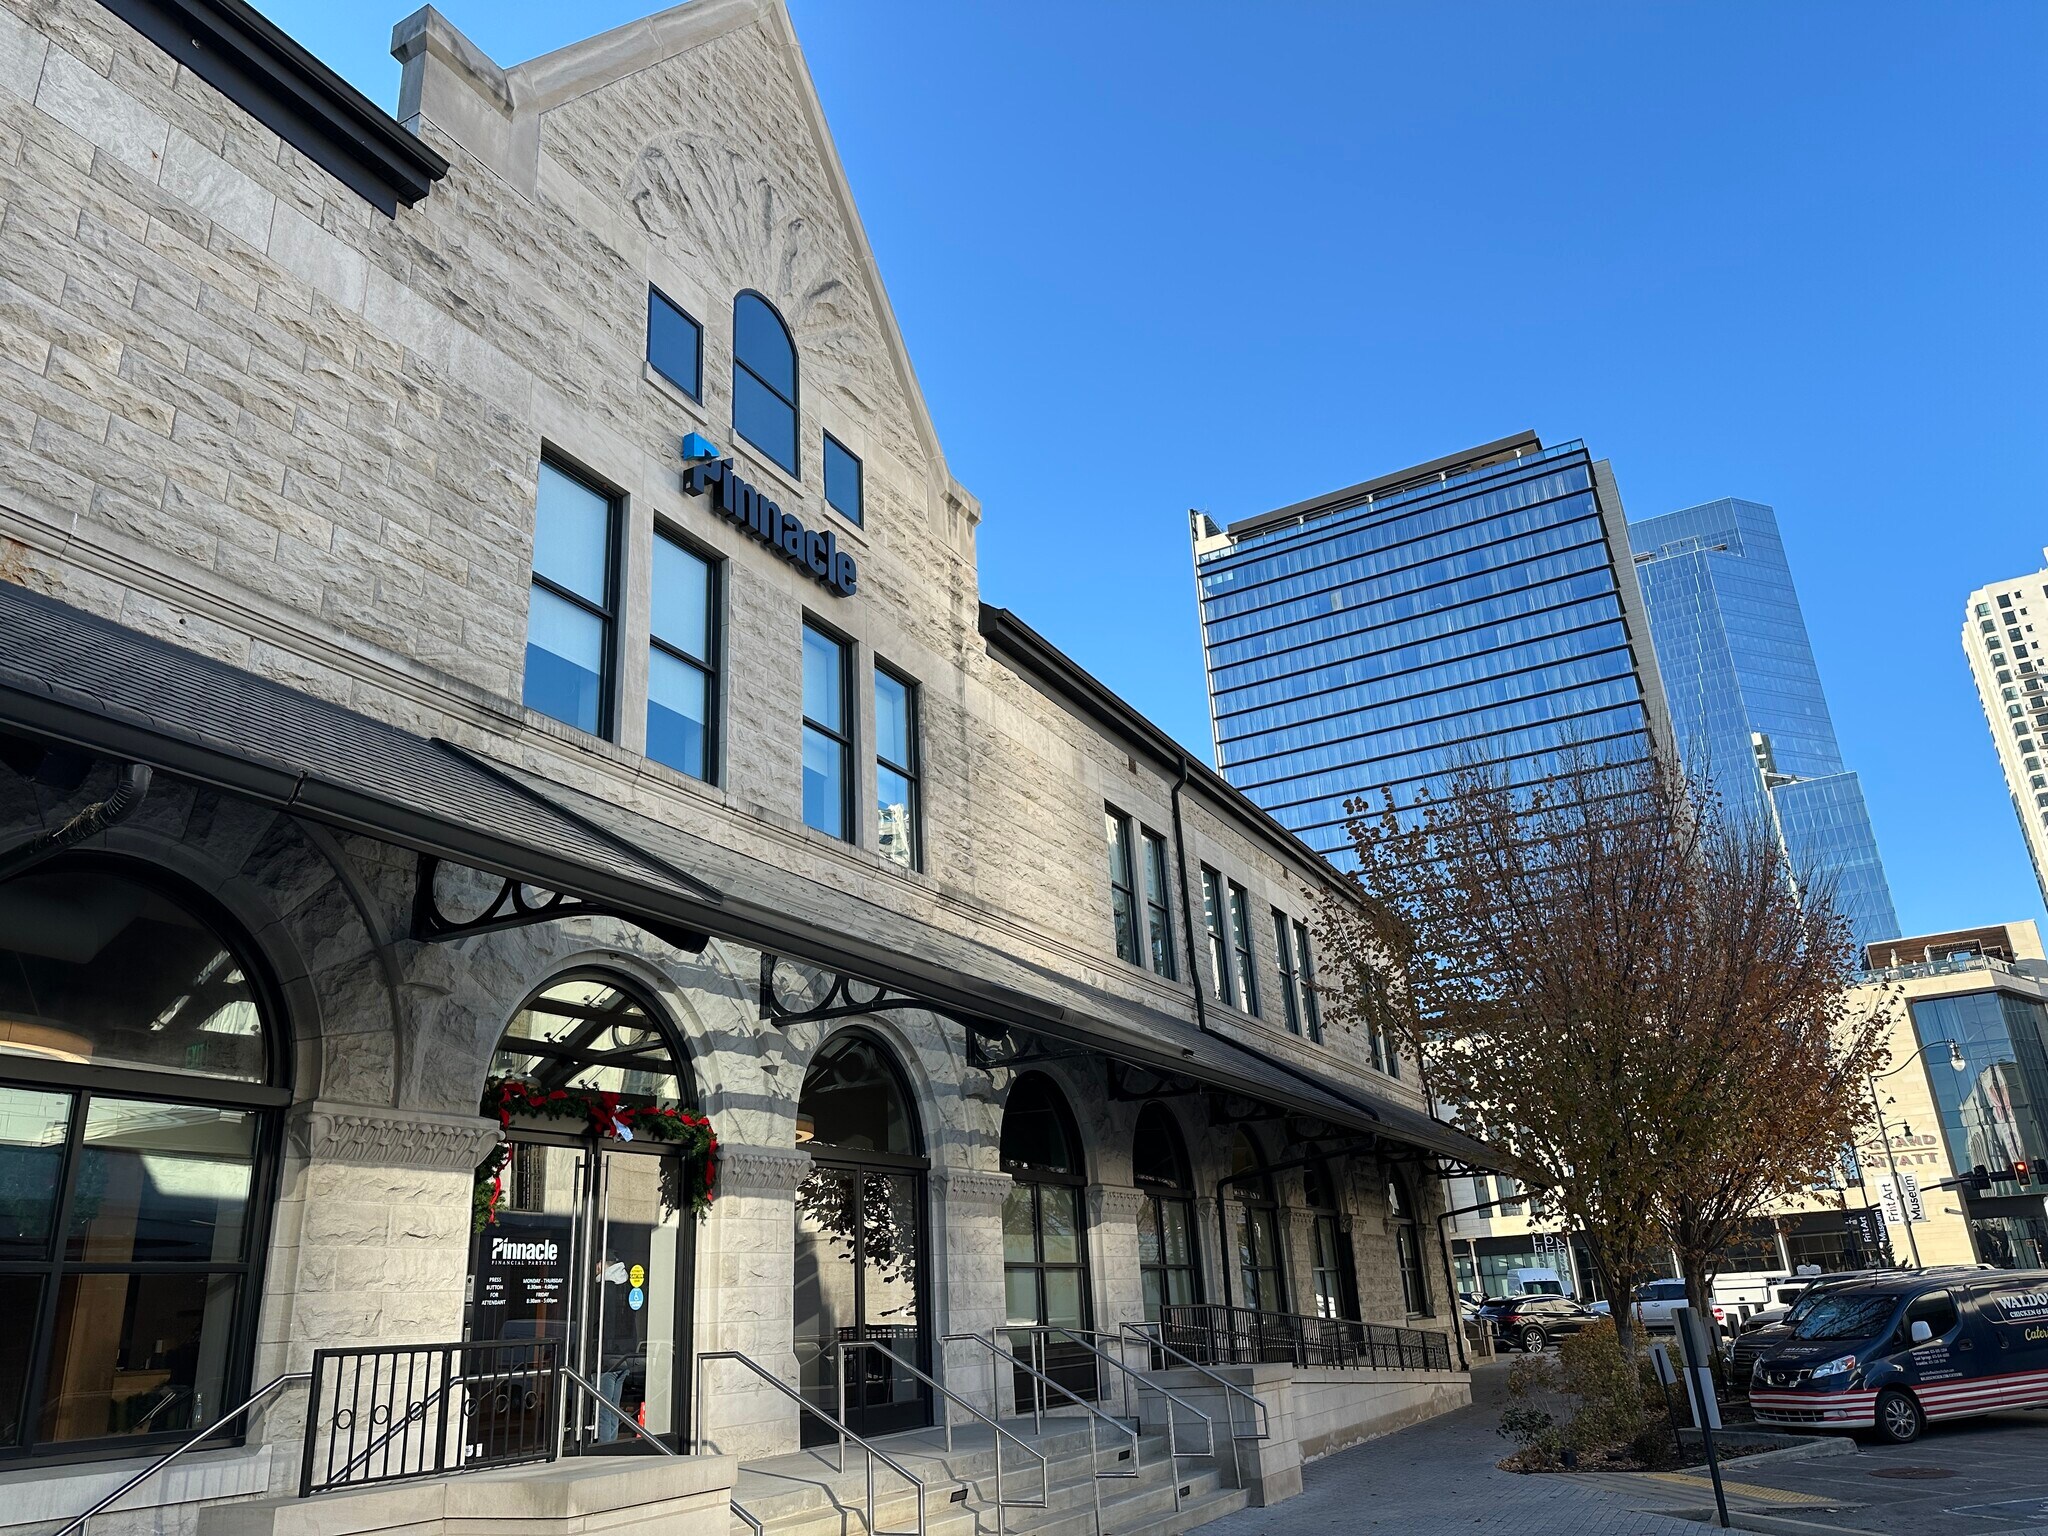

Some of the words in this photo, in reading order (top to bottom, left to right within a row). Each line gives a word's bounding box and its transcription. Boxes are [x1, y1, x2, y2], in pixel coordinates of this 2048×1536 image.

[682, 431, 857, 598] Pinnacle
[1904, 1175, 1922, 1220] Museum
[1874, 1210, 1888, 1241] Museum
[491, 1237, 558, 1260] Pinnacle
[2009, 1309, 2037, 1318] CHICKEN
